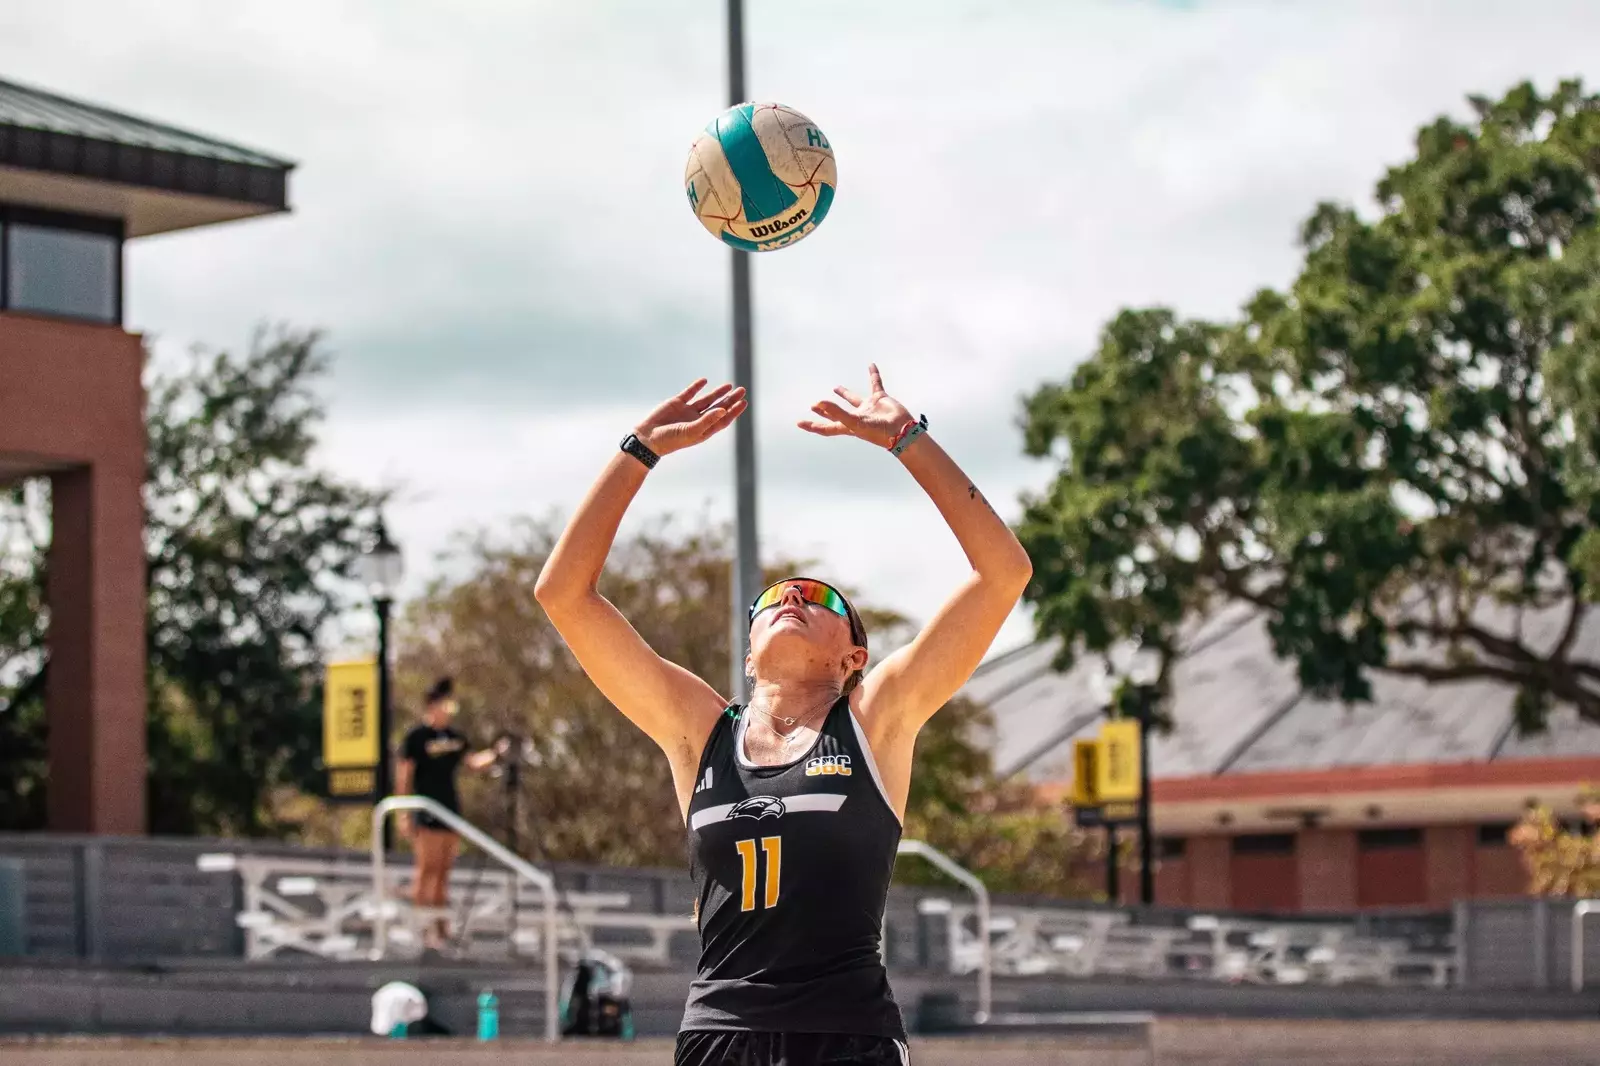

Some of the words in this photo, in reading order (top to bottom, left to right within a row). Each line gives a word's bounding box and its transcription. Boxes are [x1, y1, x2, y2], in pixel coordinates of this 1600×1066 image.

[749, 208, 808, 238] Wilson
[805, 754, 852, 776] SBC
[735, 836, 781, 912] 11
